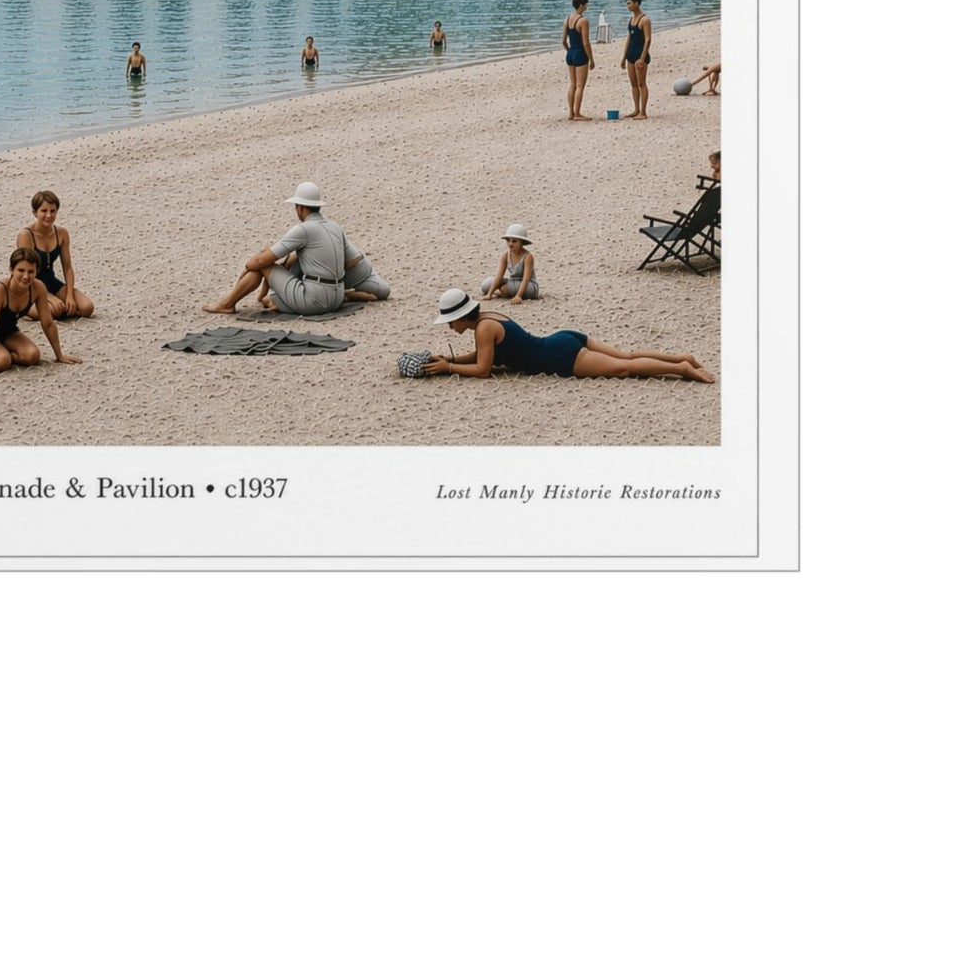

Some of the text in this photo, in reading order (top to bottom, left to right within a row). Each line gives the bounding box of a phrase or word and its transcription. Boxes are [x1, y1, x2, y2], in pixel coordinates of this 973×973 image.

[65, 476, 87, 499] &
[97, 476, 195, 499] Pavilion
[224, 477, 288, 499] c1937
[435, 484, 721, 504] Lost Manly Historic Restorations
